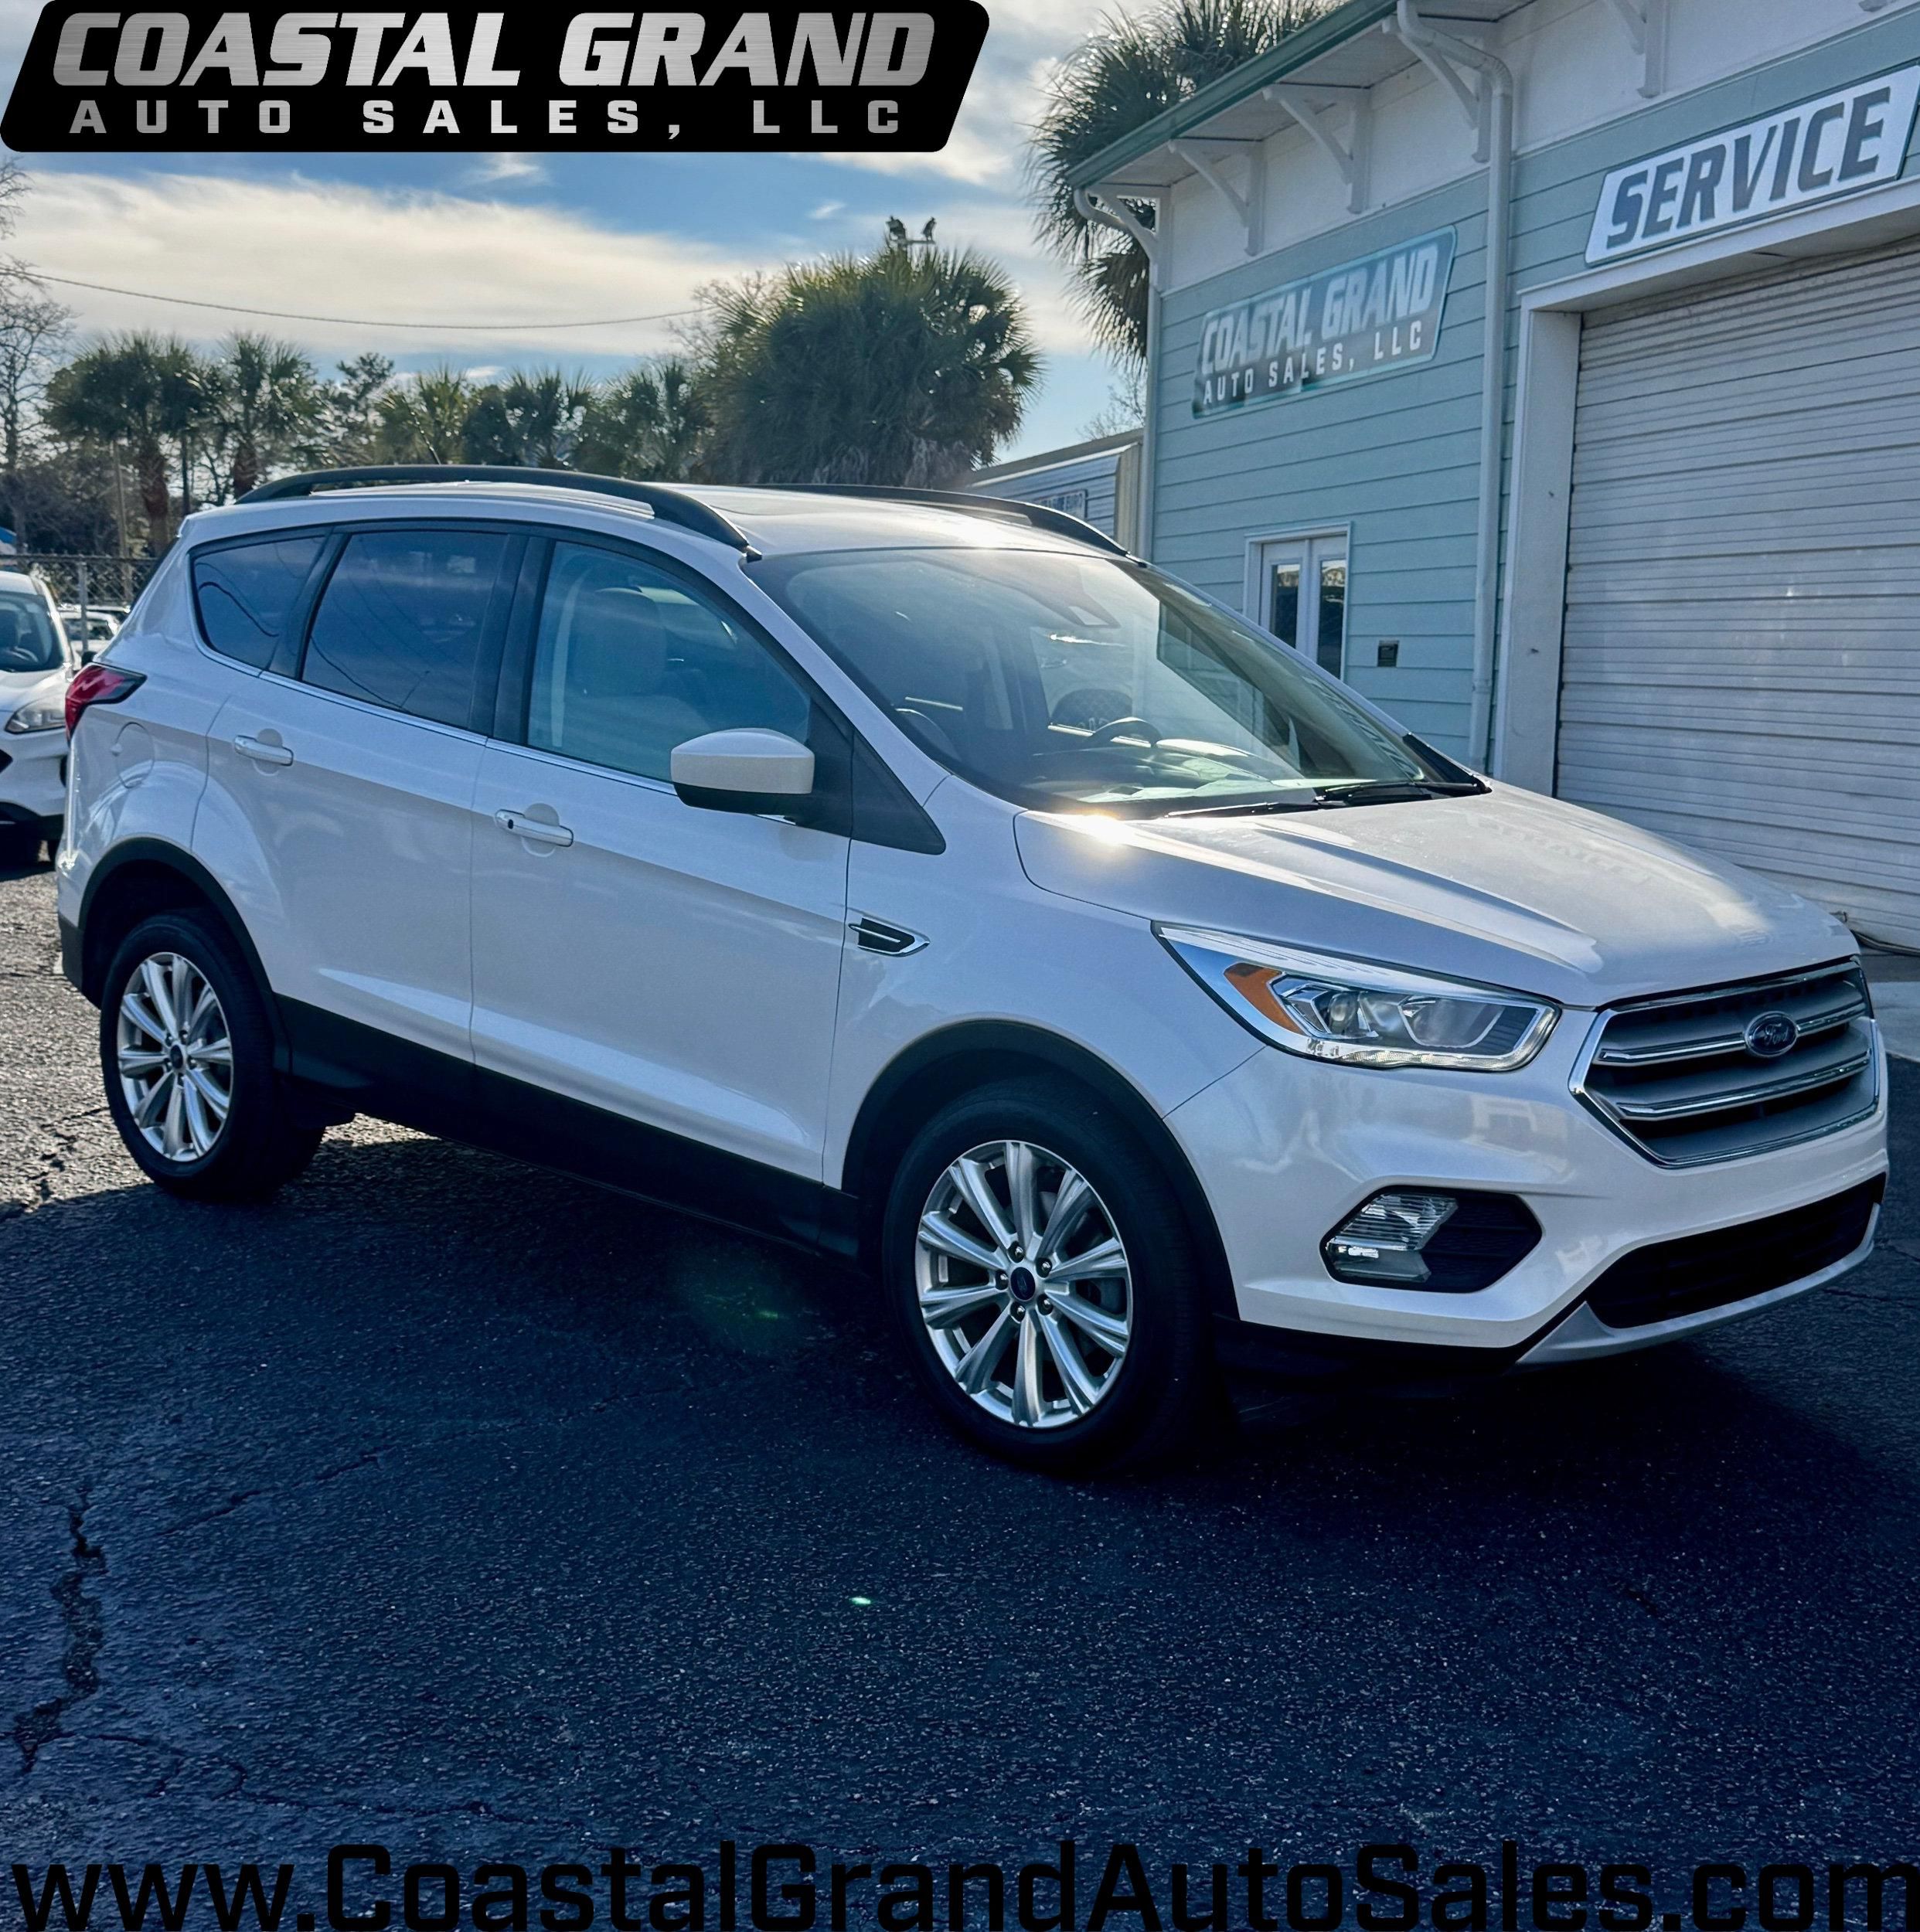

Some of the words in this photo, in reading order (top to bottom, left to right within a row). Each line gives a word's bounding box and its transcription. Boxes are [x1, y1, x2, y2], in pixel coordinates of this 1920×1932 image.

[1606, 86, 1891, 250] SERVICE
[1201, 288, 1313, 376] COASTAL
[1321, 243, 1438, 342] GRAND
[1203, 369, 1253, 405] AUTO
[1268, 343, 1354, 387] SALES,
[1374, 320, 1421, 361] LLC
[1763, 1022, 1789, 1046] Ford
